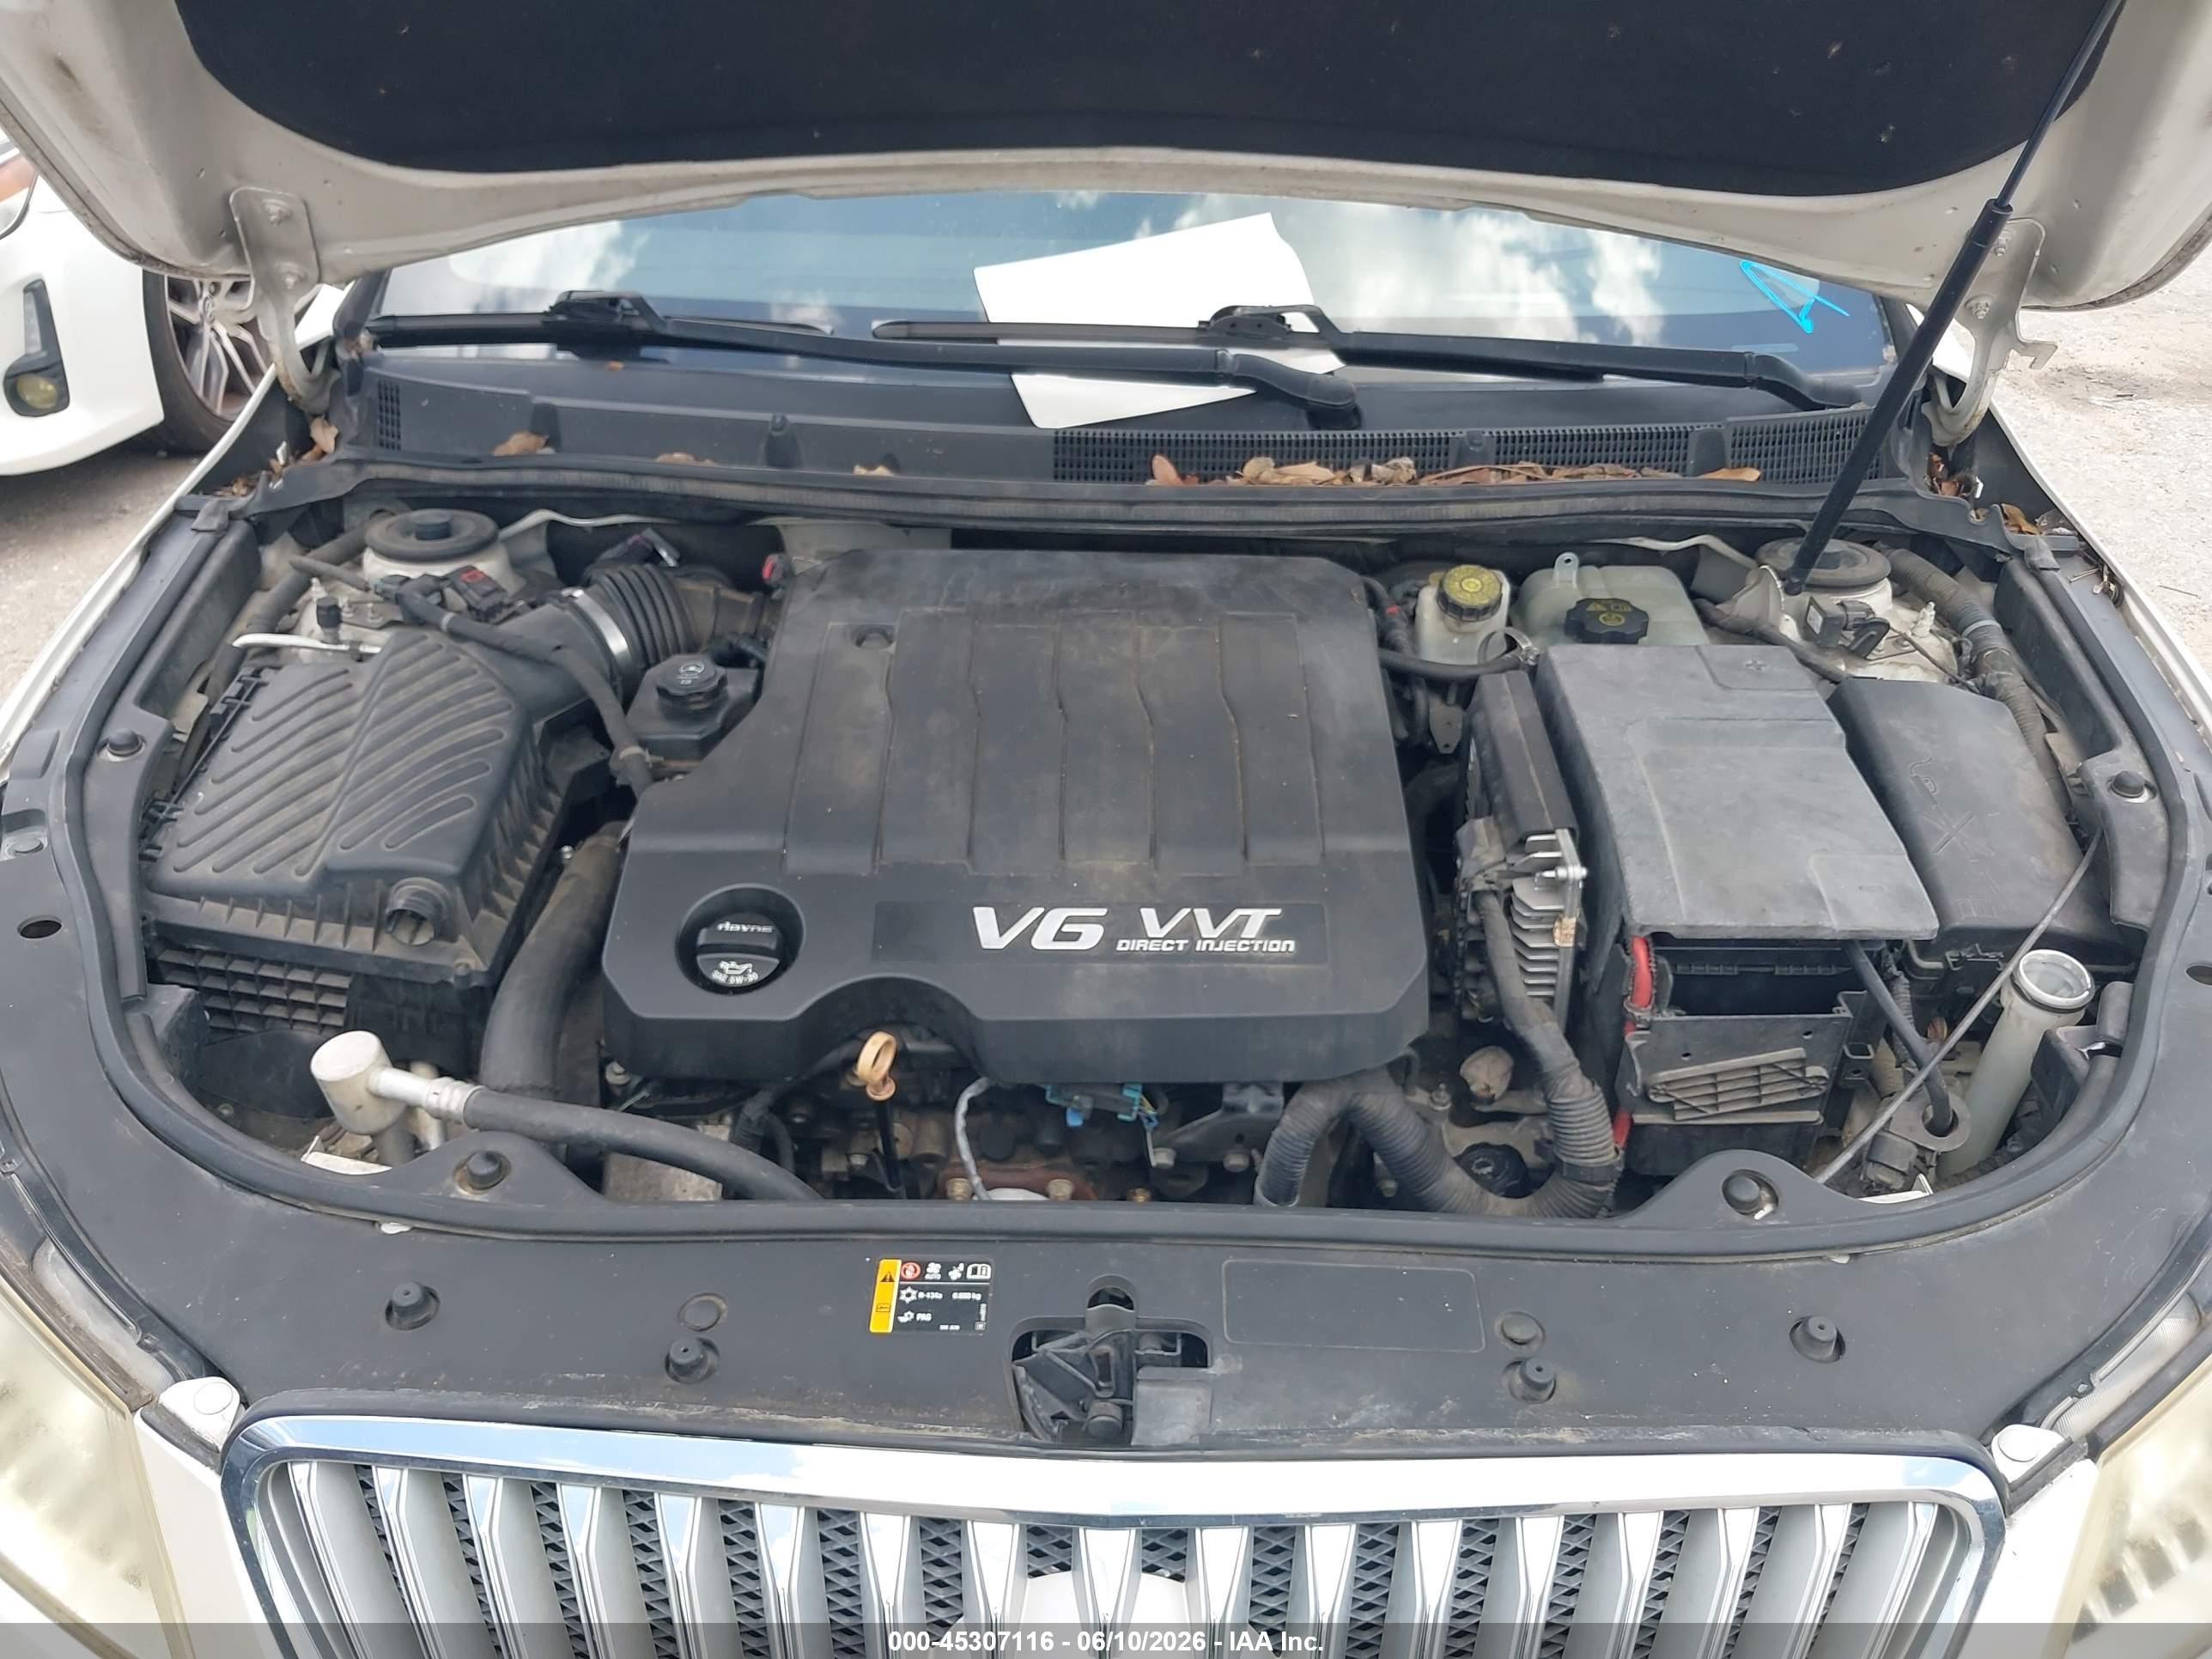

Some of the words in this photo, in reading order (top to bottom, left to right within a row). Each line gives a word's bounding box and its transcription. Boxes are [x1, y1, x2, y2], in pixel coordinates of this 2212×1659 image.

[972, 907, 1108, 950] V6
[1139, 908, 1282, 939] VVT
[1115, 939, 1188, 952] DIRECT
[1194, 939, 1295, 953] INJECTION
